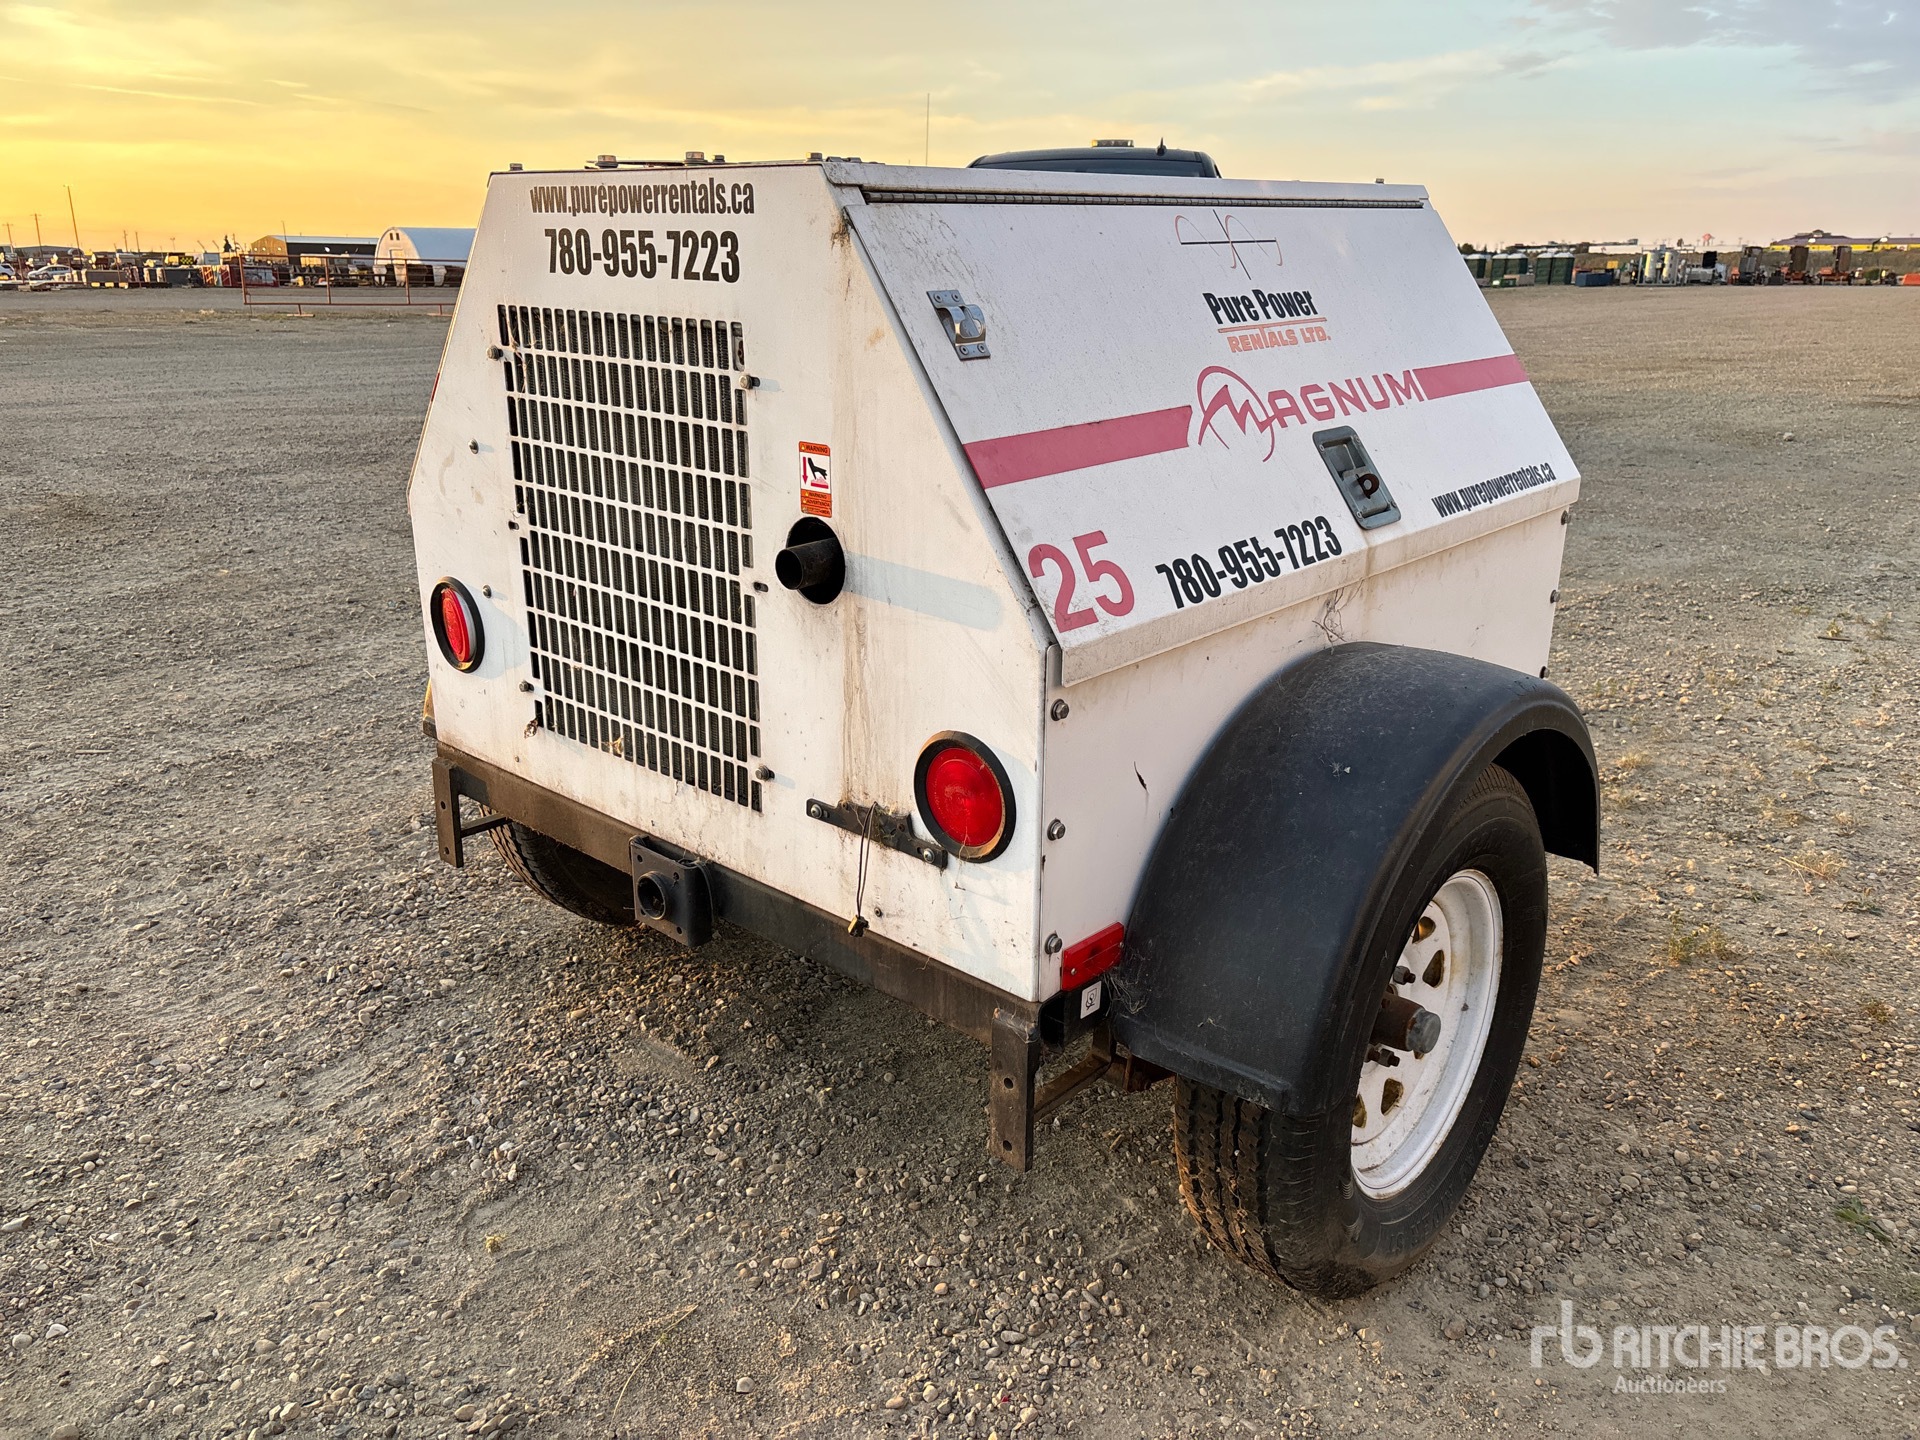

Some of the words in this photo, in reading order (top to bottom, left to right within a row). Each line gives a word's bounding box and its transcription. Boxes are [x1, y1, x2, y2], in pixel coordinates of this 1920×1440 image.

[530, 177, 755, 217] www.purepowerrentals.ca
[545, 227, 740, 283] 780-955-7223
[1202, 291, 1259, 325] Pure
[1251, 288, 1320, 320] Power
[1226, 325, 1298, 353] RENTALS
[1300, 326, 1331, 344] LTD.
[1198, 369, 1425, 446] MAGNUM
[1431, 463, 1557, 519] www.purepowerrentals.ca
[1028, 530, 1135, 633] 25
[1155, 515, 1342, 609] 780-955-7223
